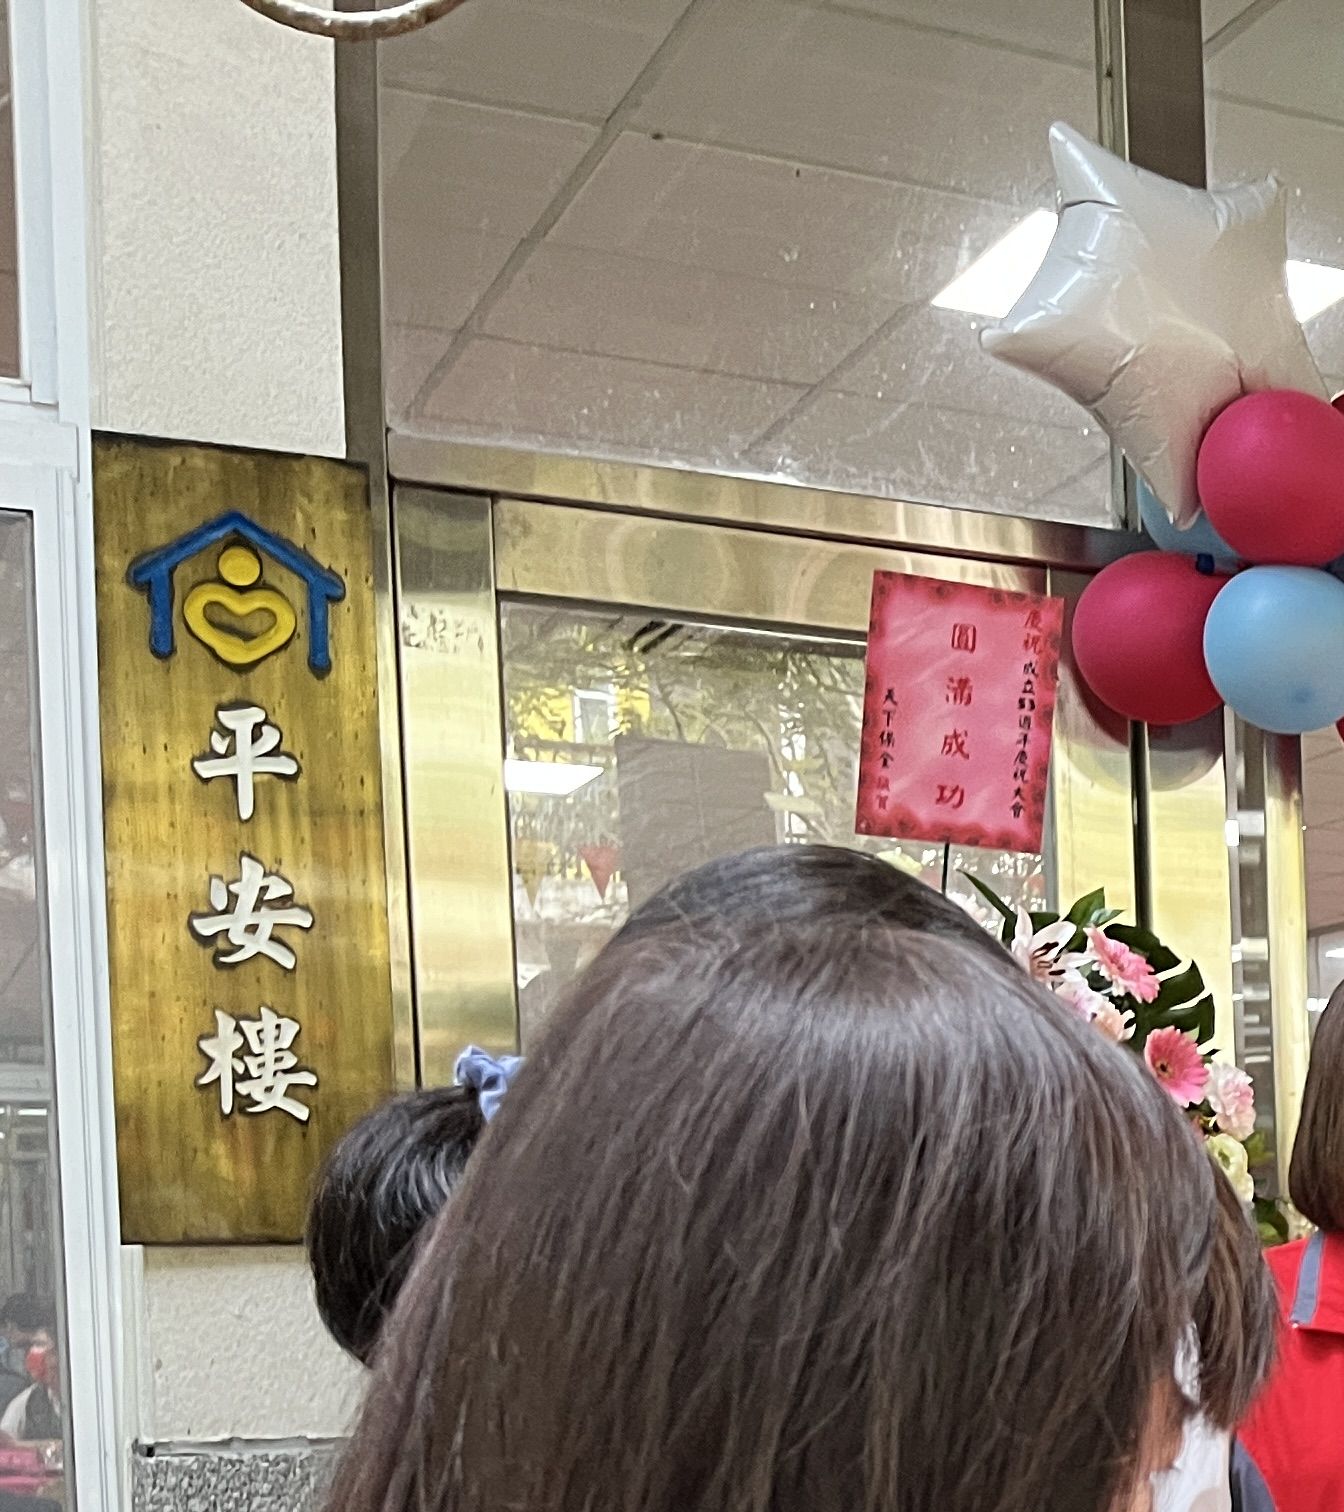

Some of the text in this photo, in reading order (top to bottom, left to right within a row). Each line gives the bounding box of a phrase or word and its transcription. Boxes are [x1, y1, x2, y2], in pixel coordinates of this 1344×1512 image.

[935, 622, 977, 809] 圓滿成功
[192, 705, 318, 1122] 平安樓
